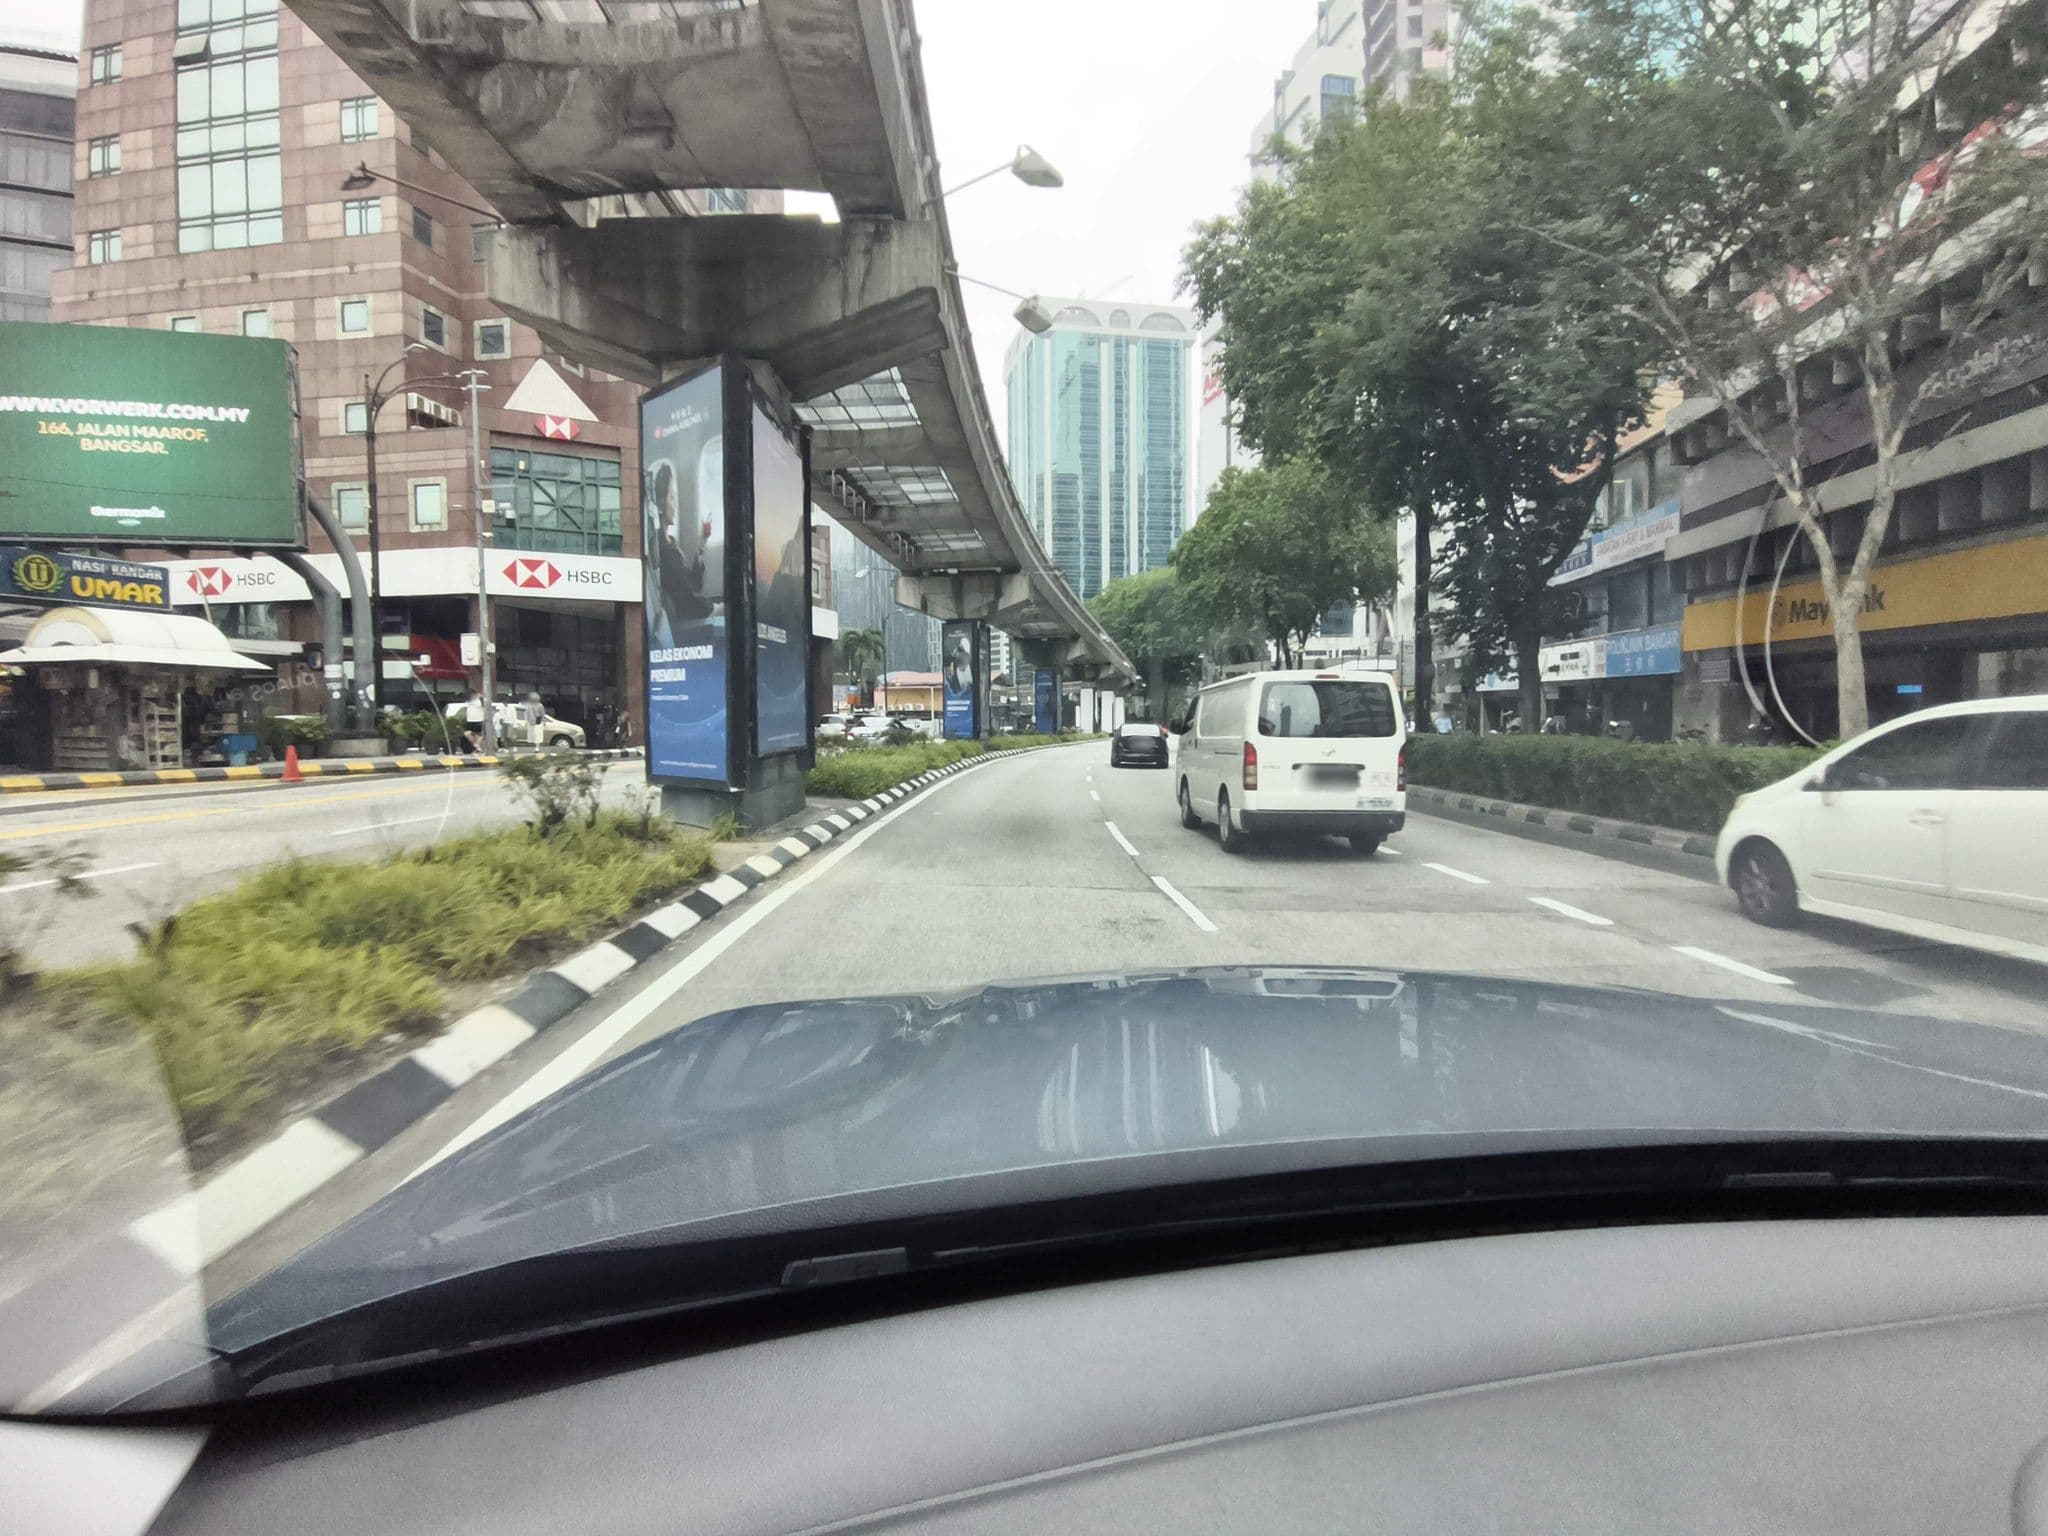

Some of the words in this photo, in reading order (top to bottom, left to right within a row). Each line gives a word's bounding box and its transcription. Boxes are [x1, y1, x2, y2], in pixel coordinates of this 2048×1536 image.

[76, 422, 129, 437] JALAN
[72, 559, 105, 573] NASI
[111, 563, 163, 581] KANDAR
[236, 572, 276, 586] HSBC
[566, 569, 613, 585] HSBC
[71, 575, 164, 605] UMAR
[1788, 583, 1888, 627] Maynk
[650, 649, 673, 664] KELAS
[673, 644, 713, 661] EKONOMI
[650, 667, 687, 683] PREMIUM
